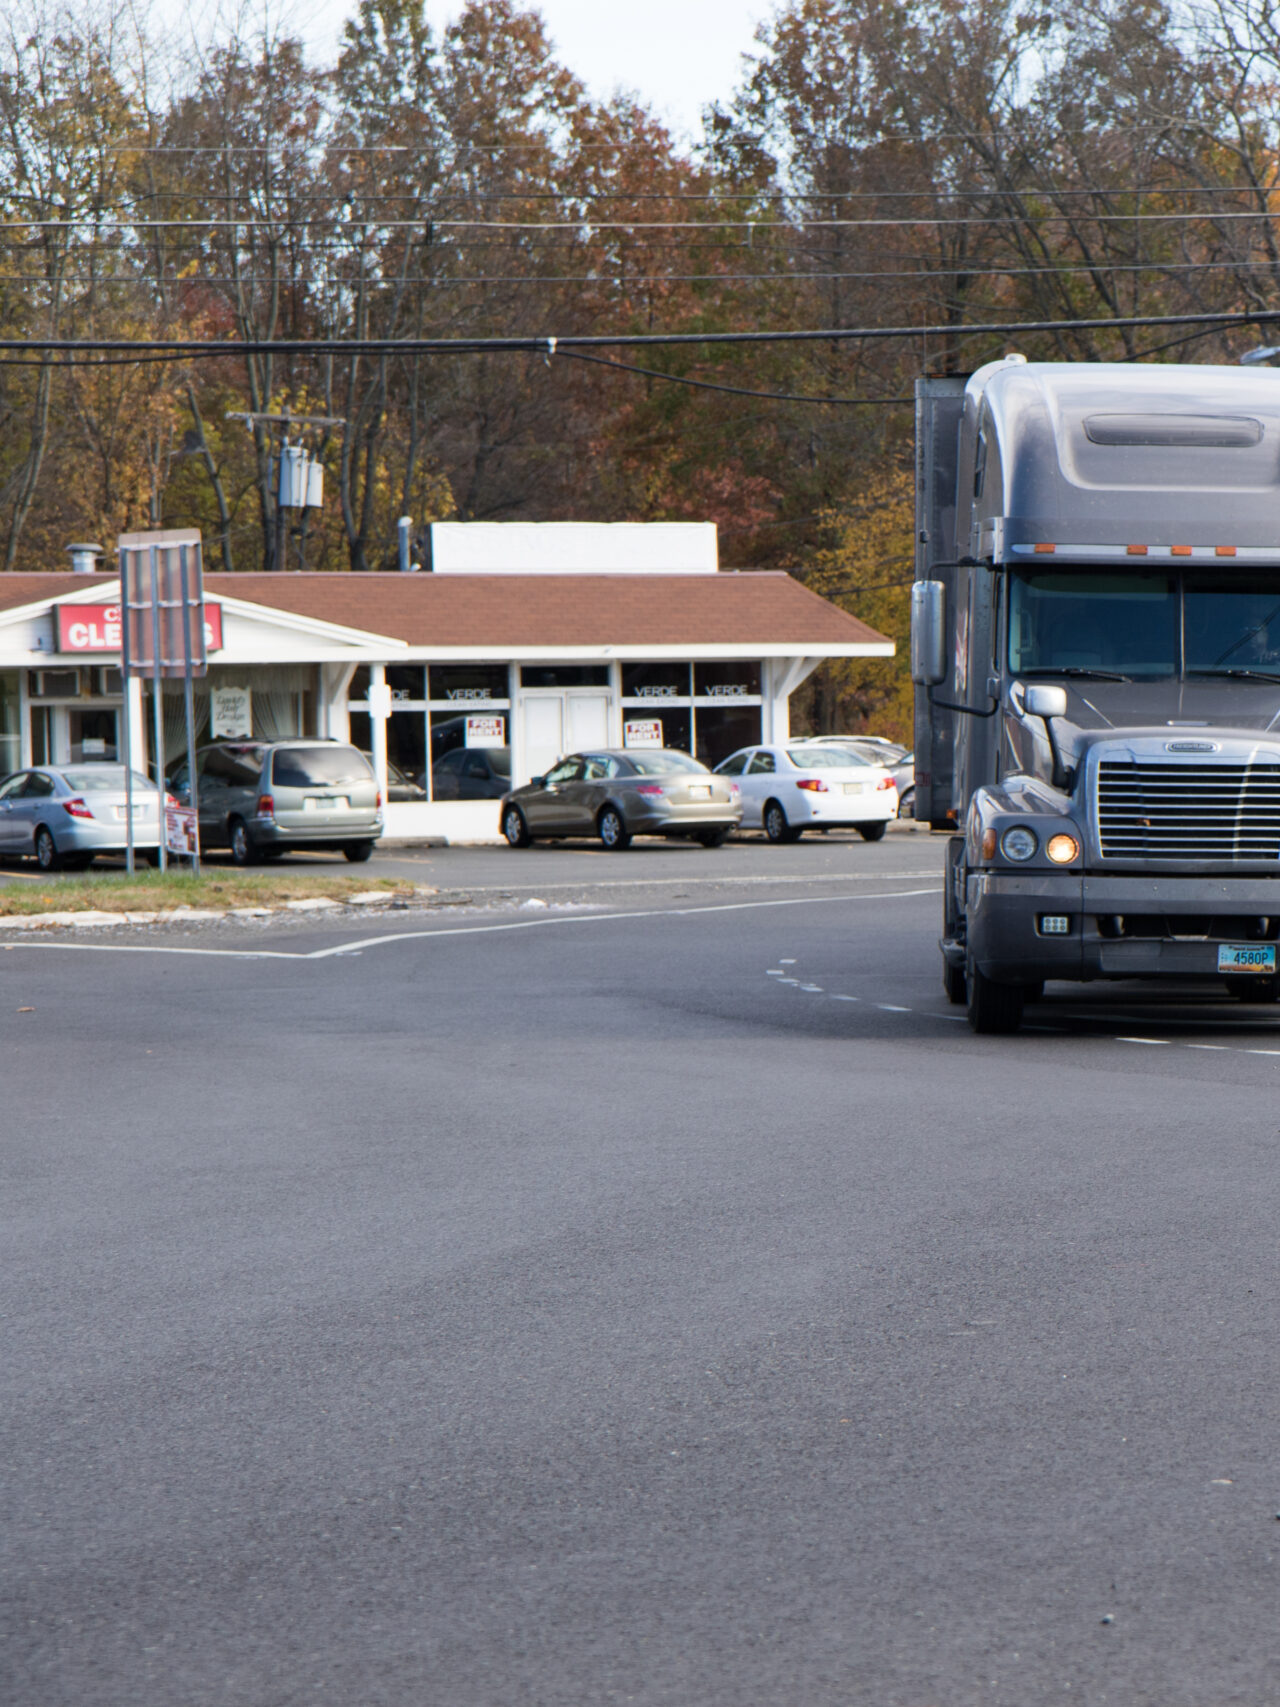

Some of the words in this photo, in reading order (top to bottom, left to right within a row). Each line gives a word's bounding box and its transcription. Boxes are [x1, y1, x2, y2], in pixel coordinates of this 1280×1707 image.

[446, 688, 492, 700] VERDE
[634, 685, 679, 697] VERDE
[705, 685, 749, 696] VERDE
[473, 719, 497, 728] FOR
[631, 723, 655, 732] FOR
[469, 728, 501, 737] RENT
[628, 731, 660, 741] RENT
[1233, 951, 1268, 965] 4580P
